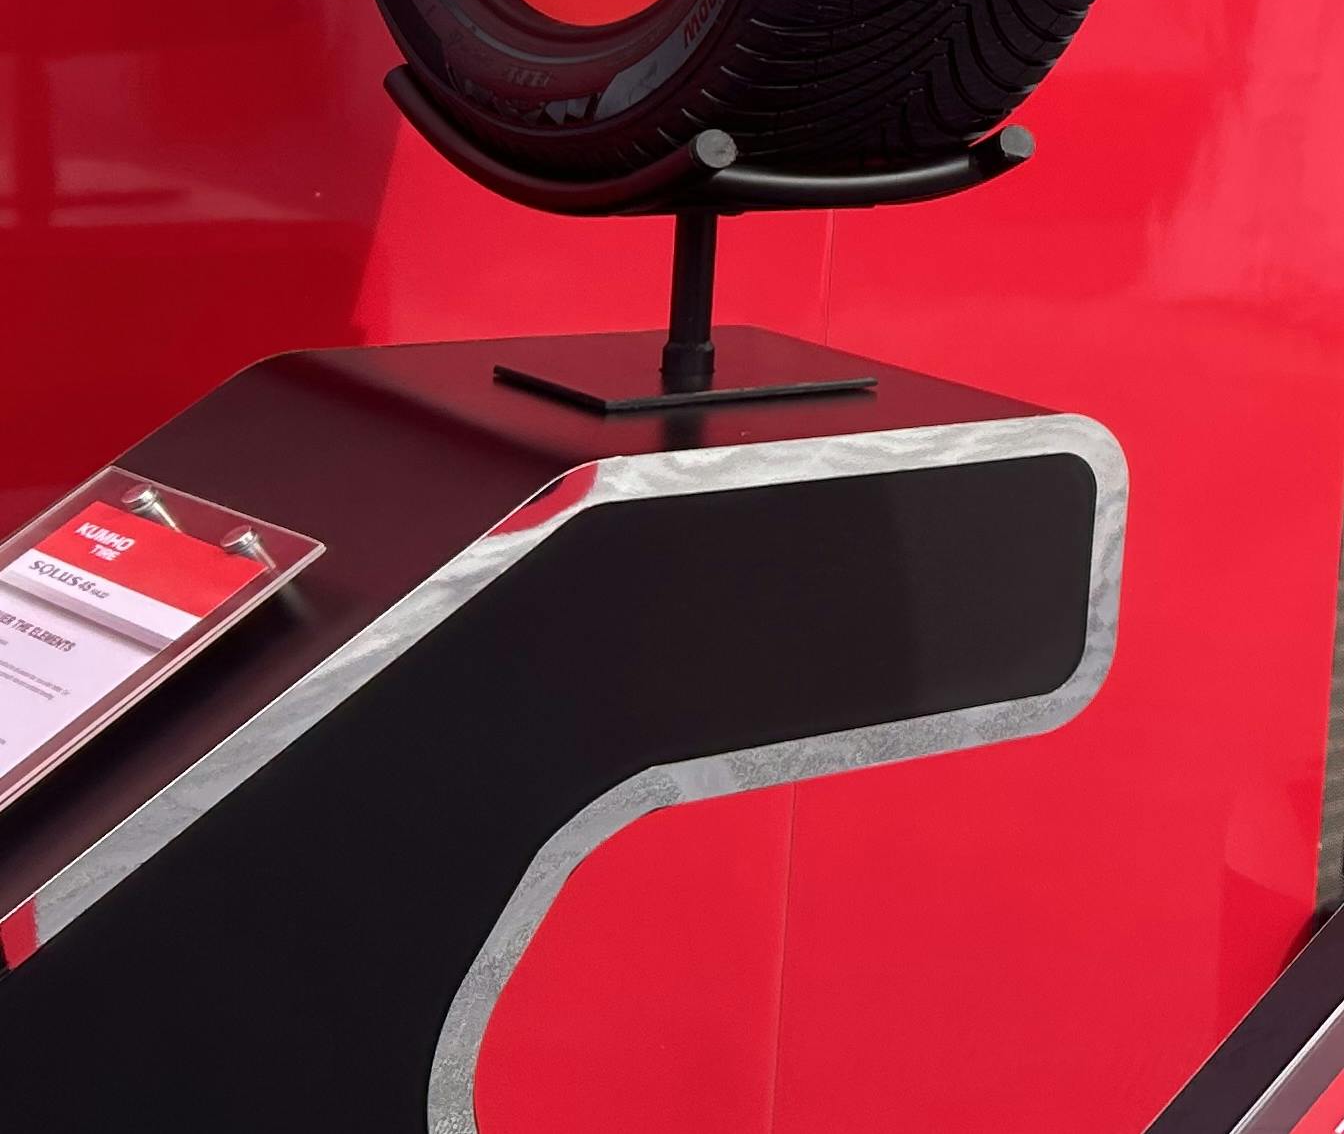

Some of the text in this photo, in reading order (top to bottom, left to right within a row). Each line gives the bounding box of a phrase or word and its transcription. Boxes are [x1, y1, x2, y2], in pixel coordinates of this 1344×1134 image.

[75, 522, 136, 552] KUMHO
[89, 544, 121, 562] TIRE
[29, 560, 82, 587] SOLUS
